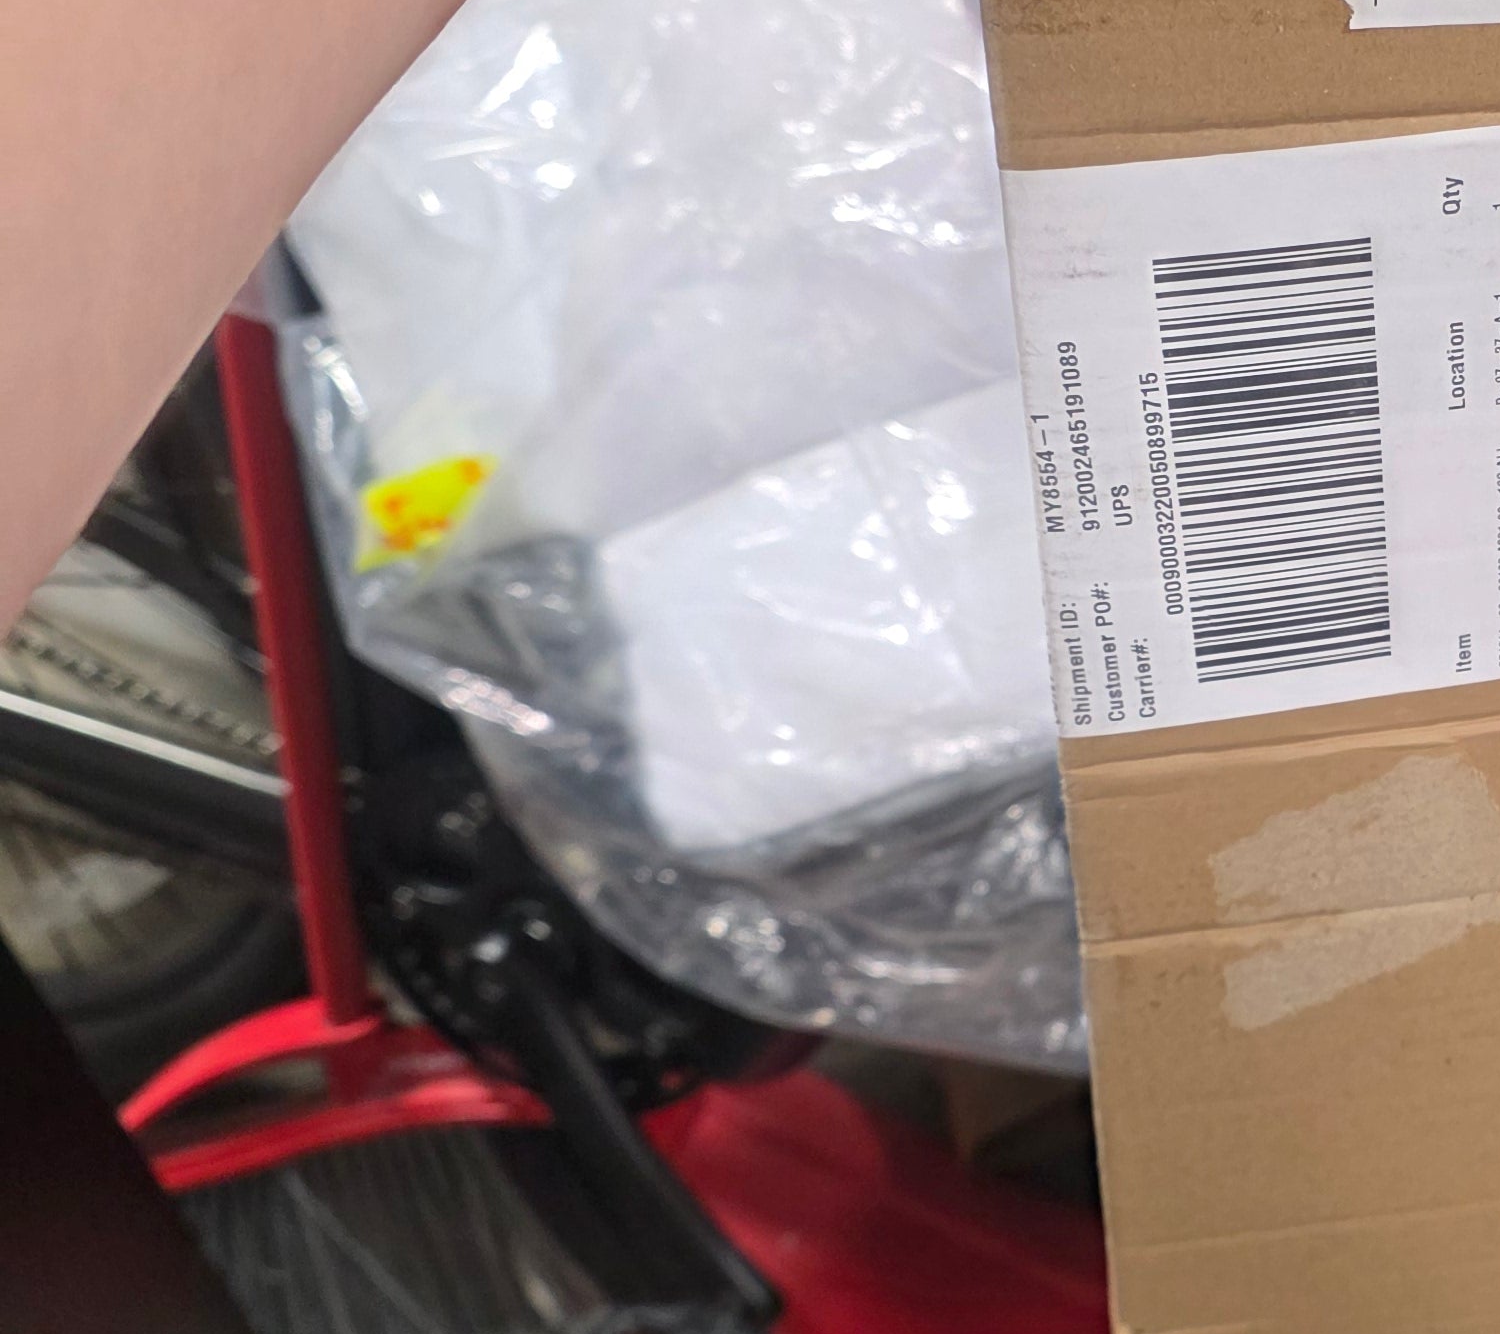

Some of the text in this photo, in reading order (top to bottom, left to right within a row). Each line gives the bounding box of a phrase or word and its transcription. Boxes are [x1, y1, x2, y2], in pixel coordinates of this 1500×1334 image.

[1030, 414, 1092, 725] Shipment ID: MY8554-1
[1057, 342, 1125, 721] Customer PO#: 912002465191089
[1139, 373, 1184, 615] 00090003220050899715
[1442, 177, 1472, 672] Item Location Qty
[1111, 485, 1156, 717] Carrier#: UPS
